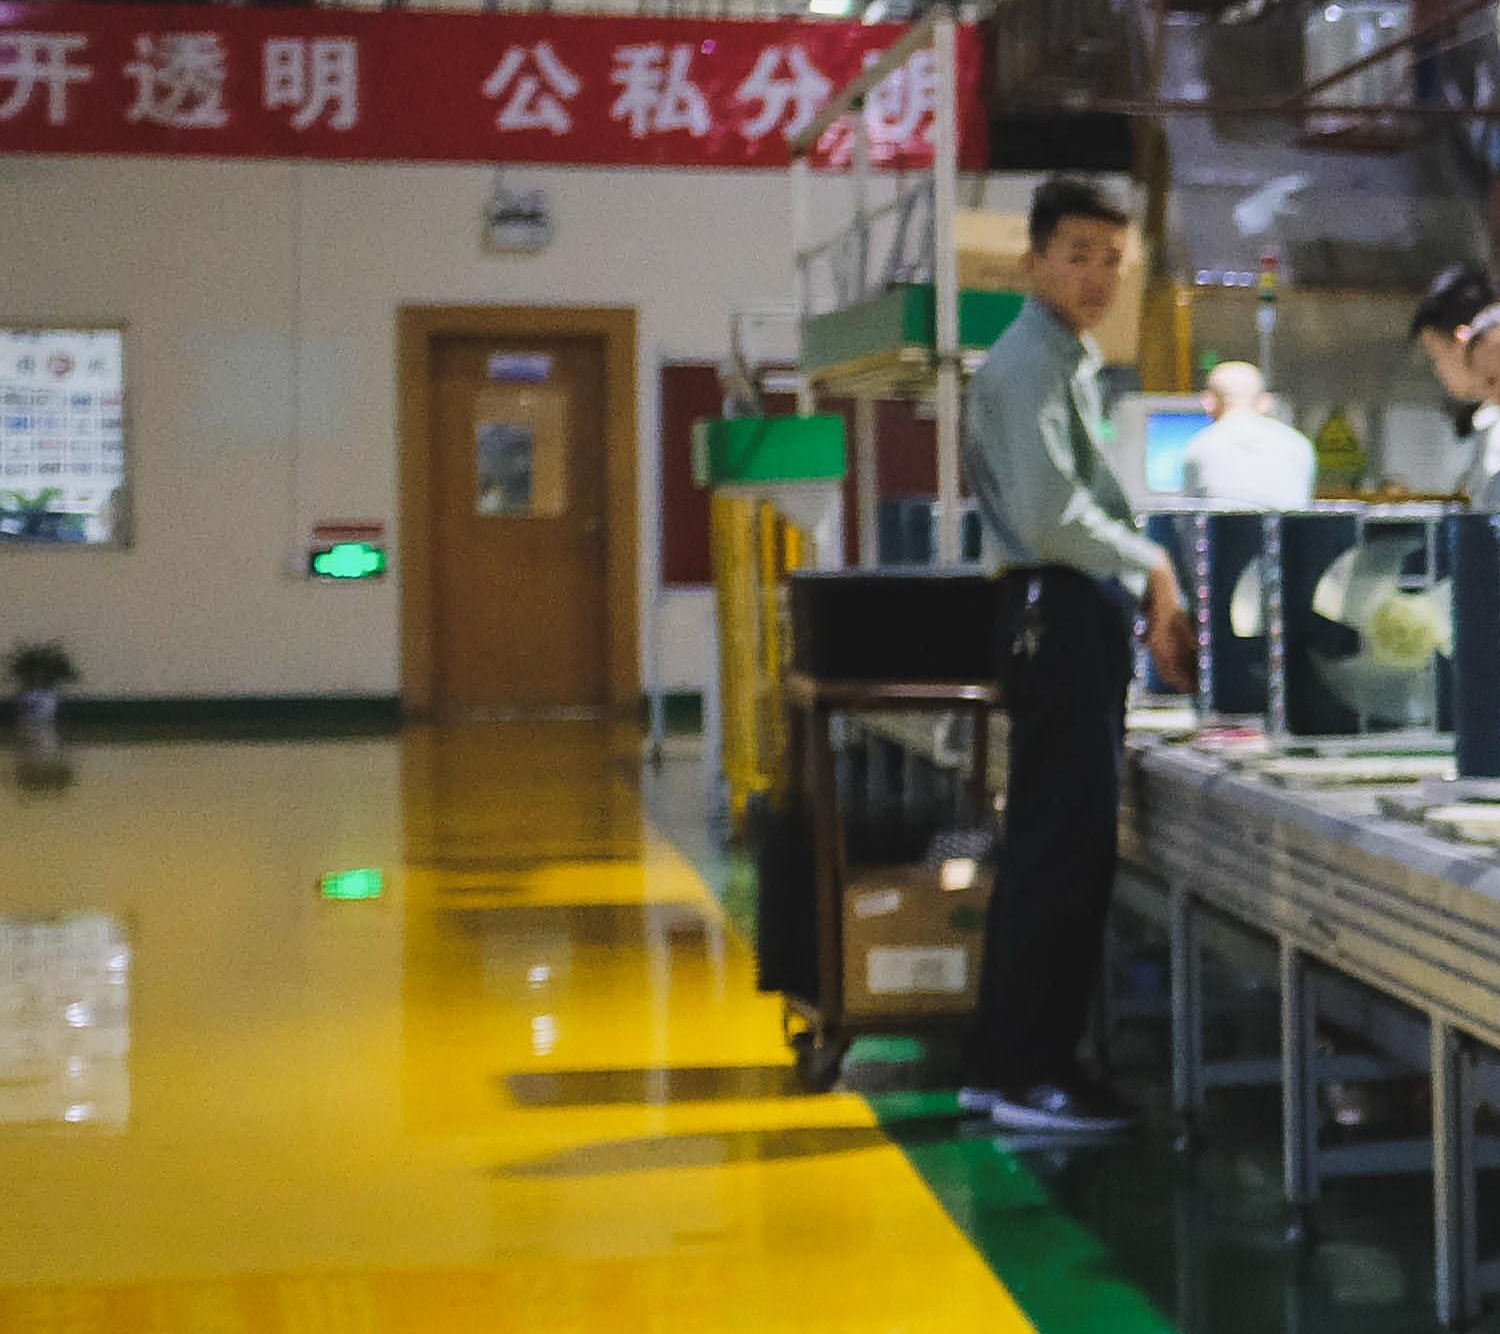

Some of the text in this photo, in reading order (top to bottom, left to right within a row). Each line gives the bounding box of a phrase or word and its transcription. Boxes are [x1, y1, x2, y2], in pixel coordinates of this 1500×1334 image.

[0, 31, 935, 141] 开透明 公私分明
